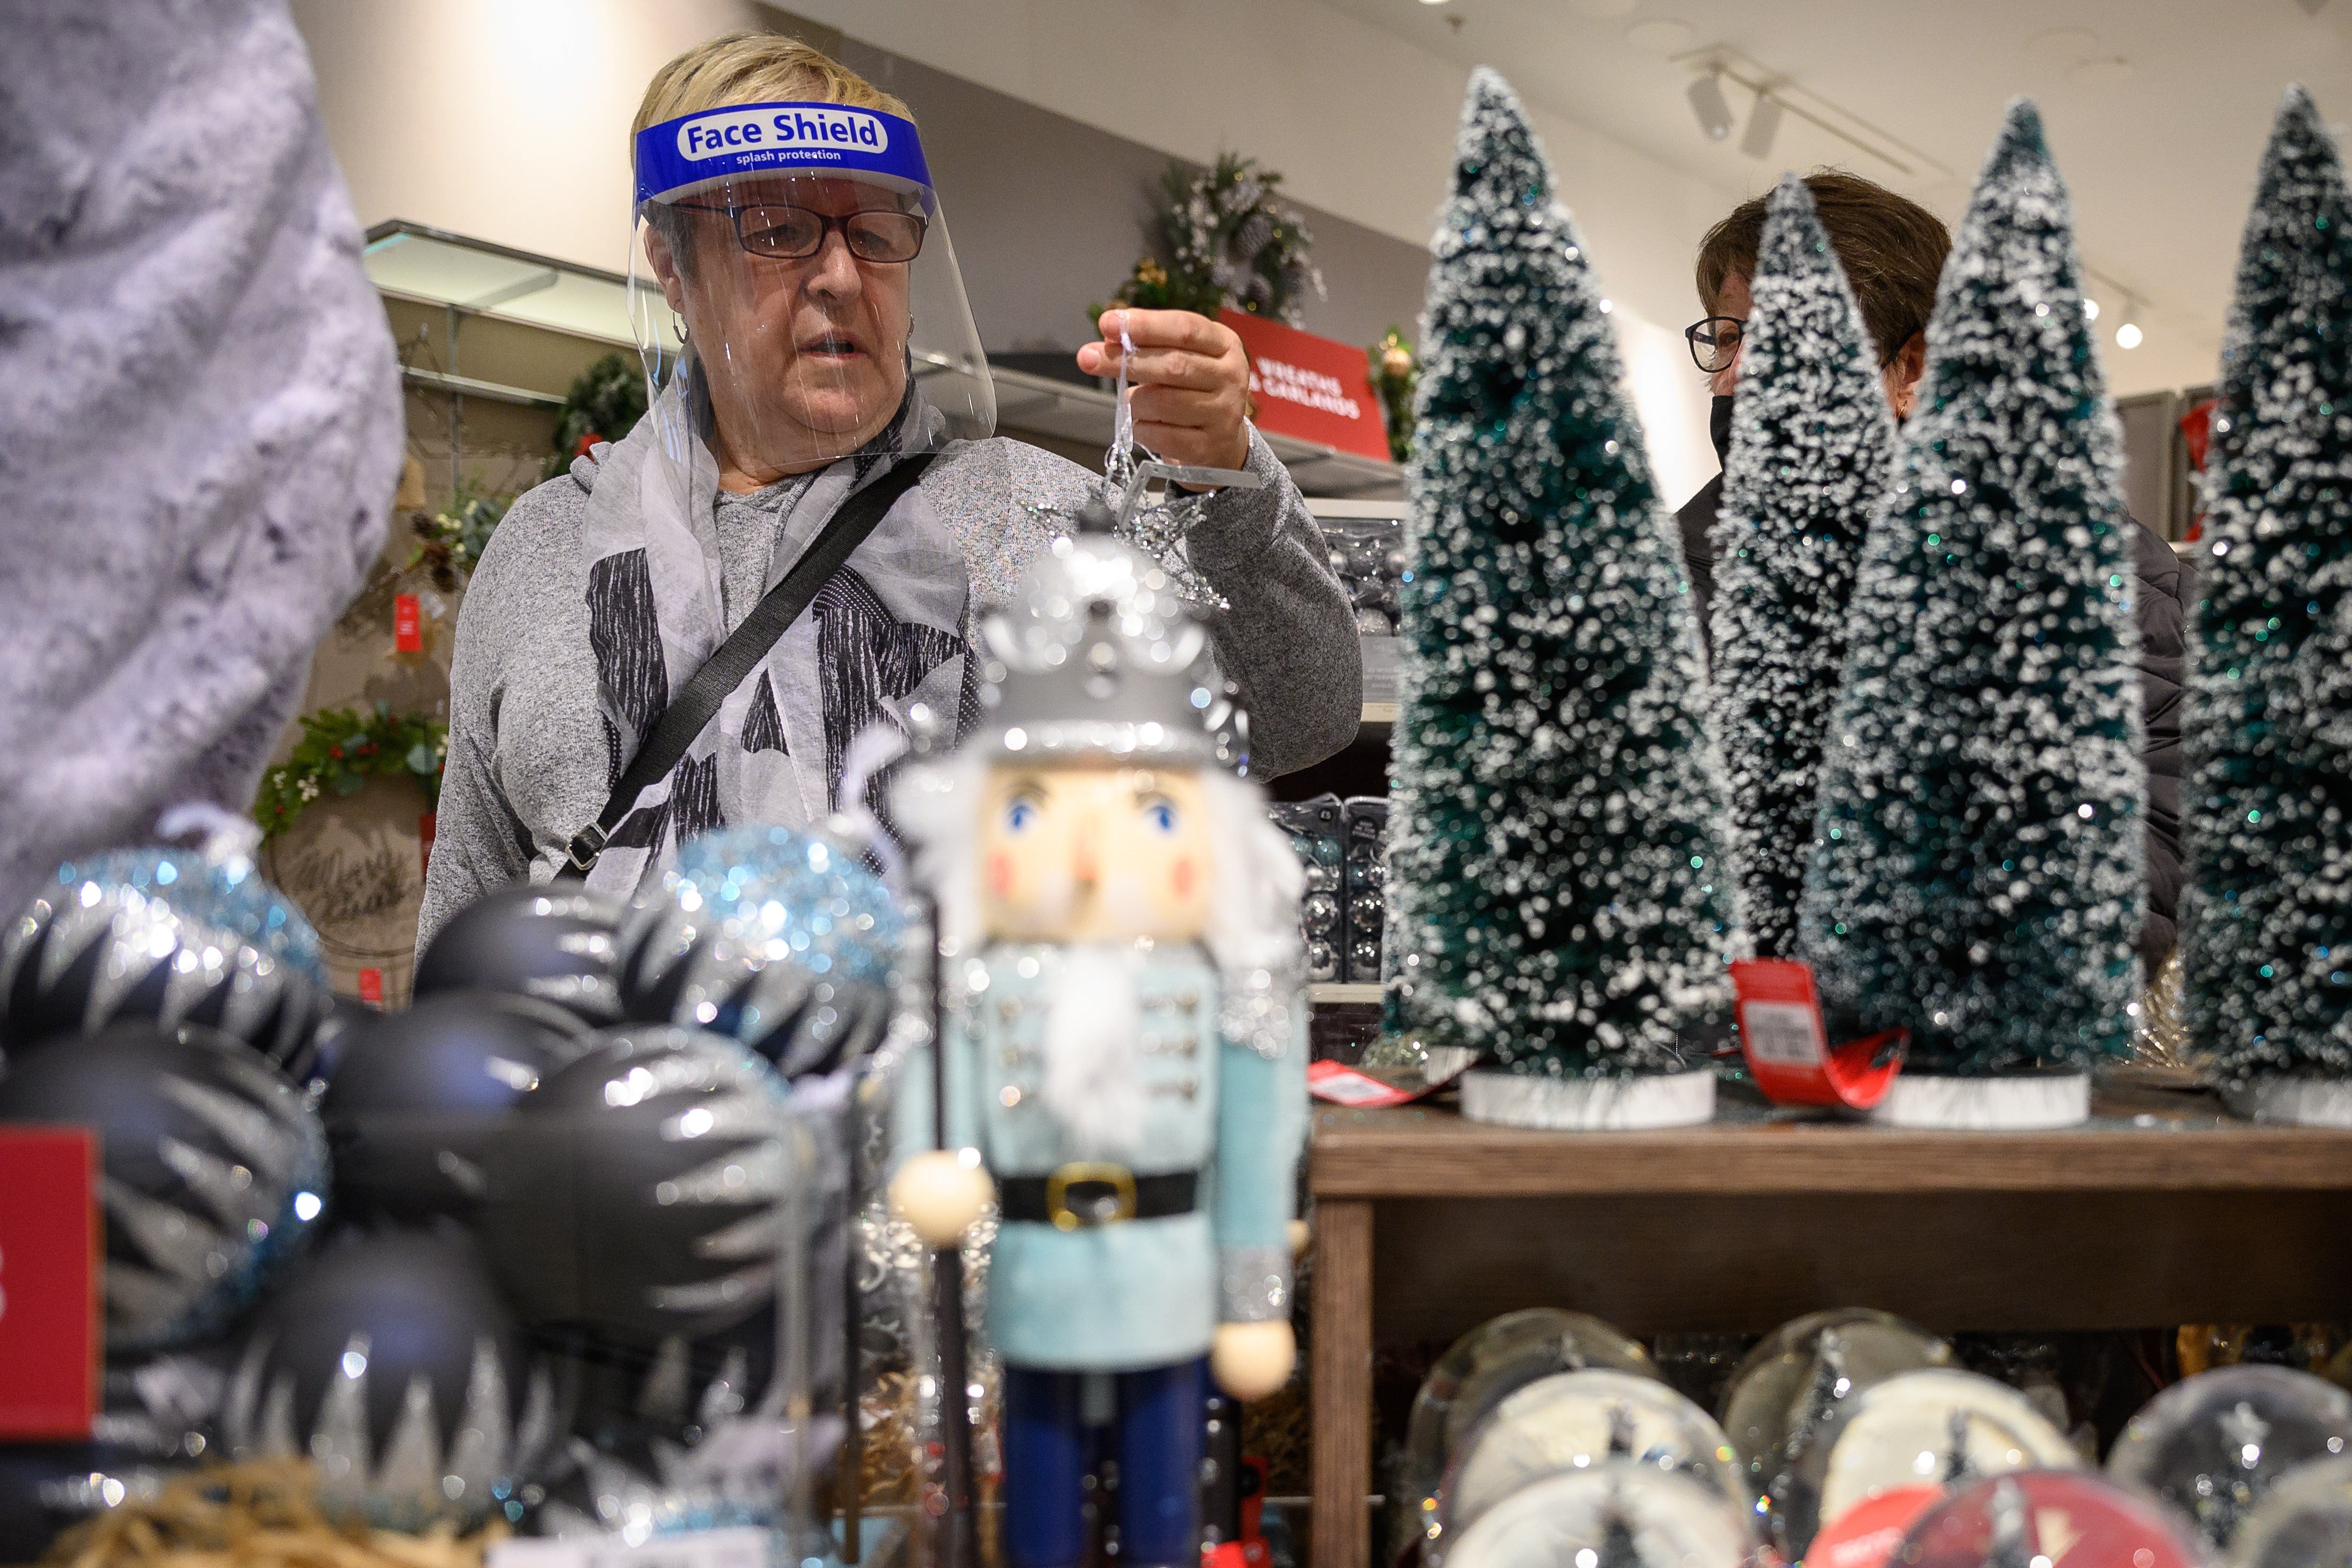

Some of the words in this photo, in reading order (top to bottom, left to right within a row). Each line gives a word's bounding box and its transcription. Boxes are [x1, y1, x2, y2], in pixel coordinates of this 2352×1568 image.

[688, 123, 762, 154] Face
[773, 113, 879, 147] Shield
[736, 151, 774, 166] splash
[778, 149, 841, 162] protection
[1263, 376, 1360, 419] GARLANDS
